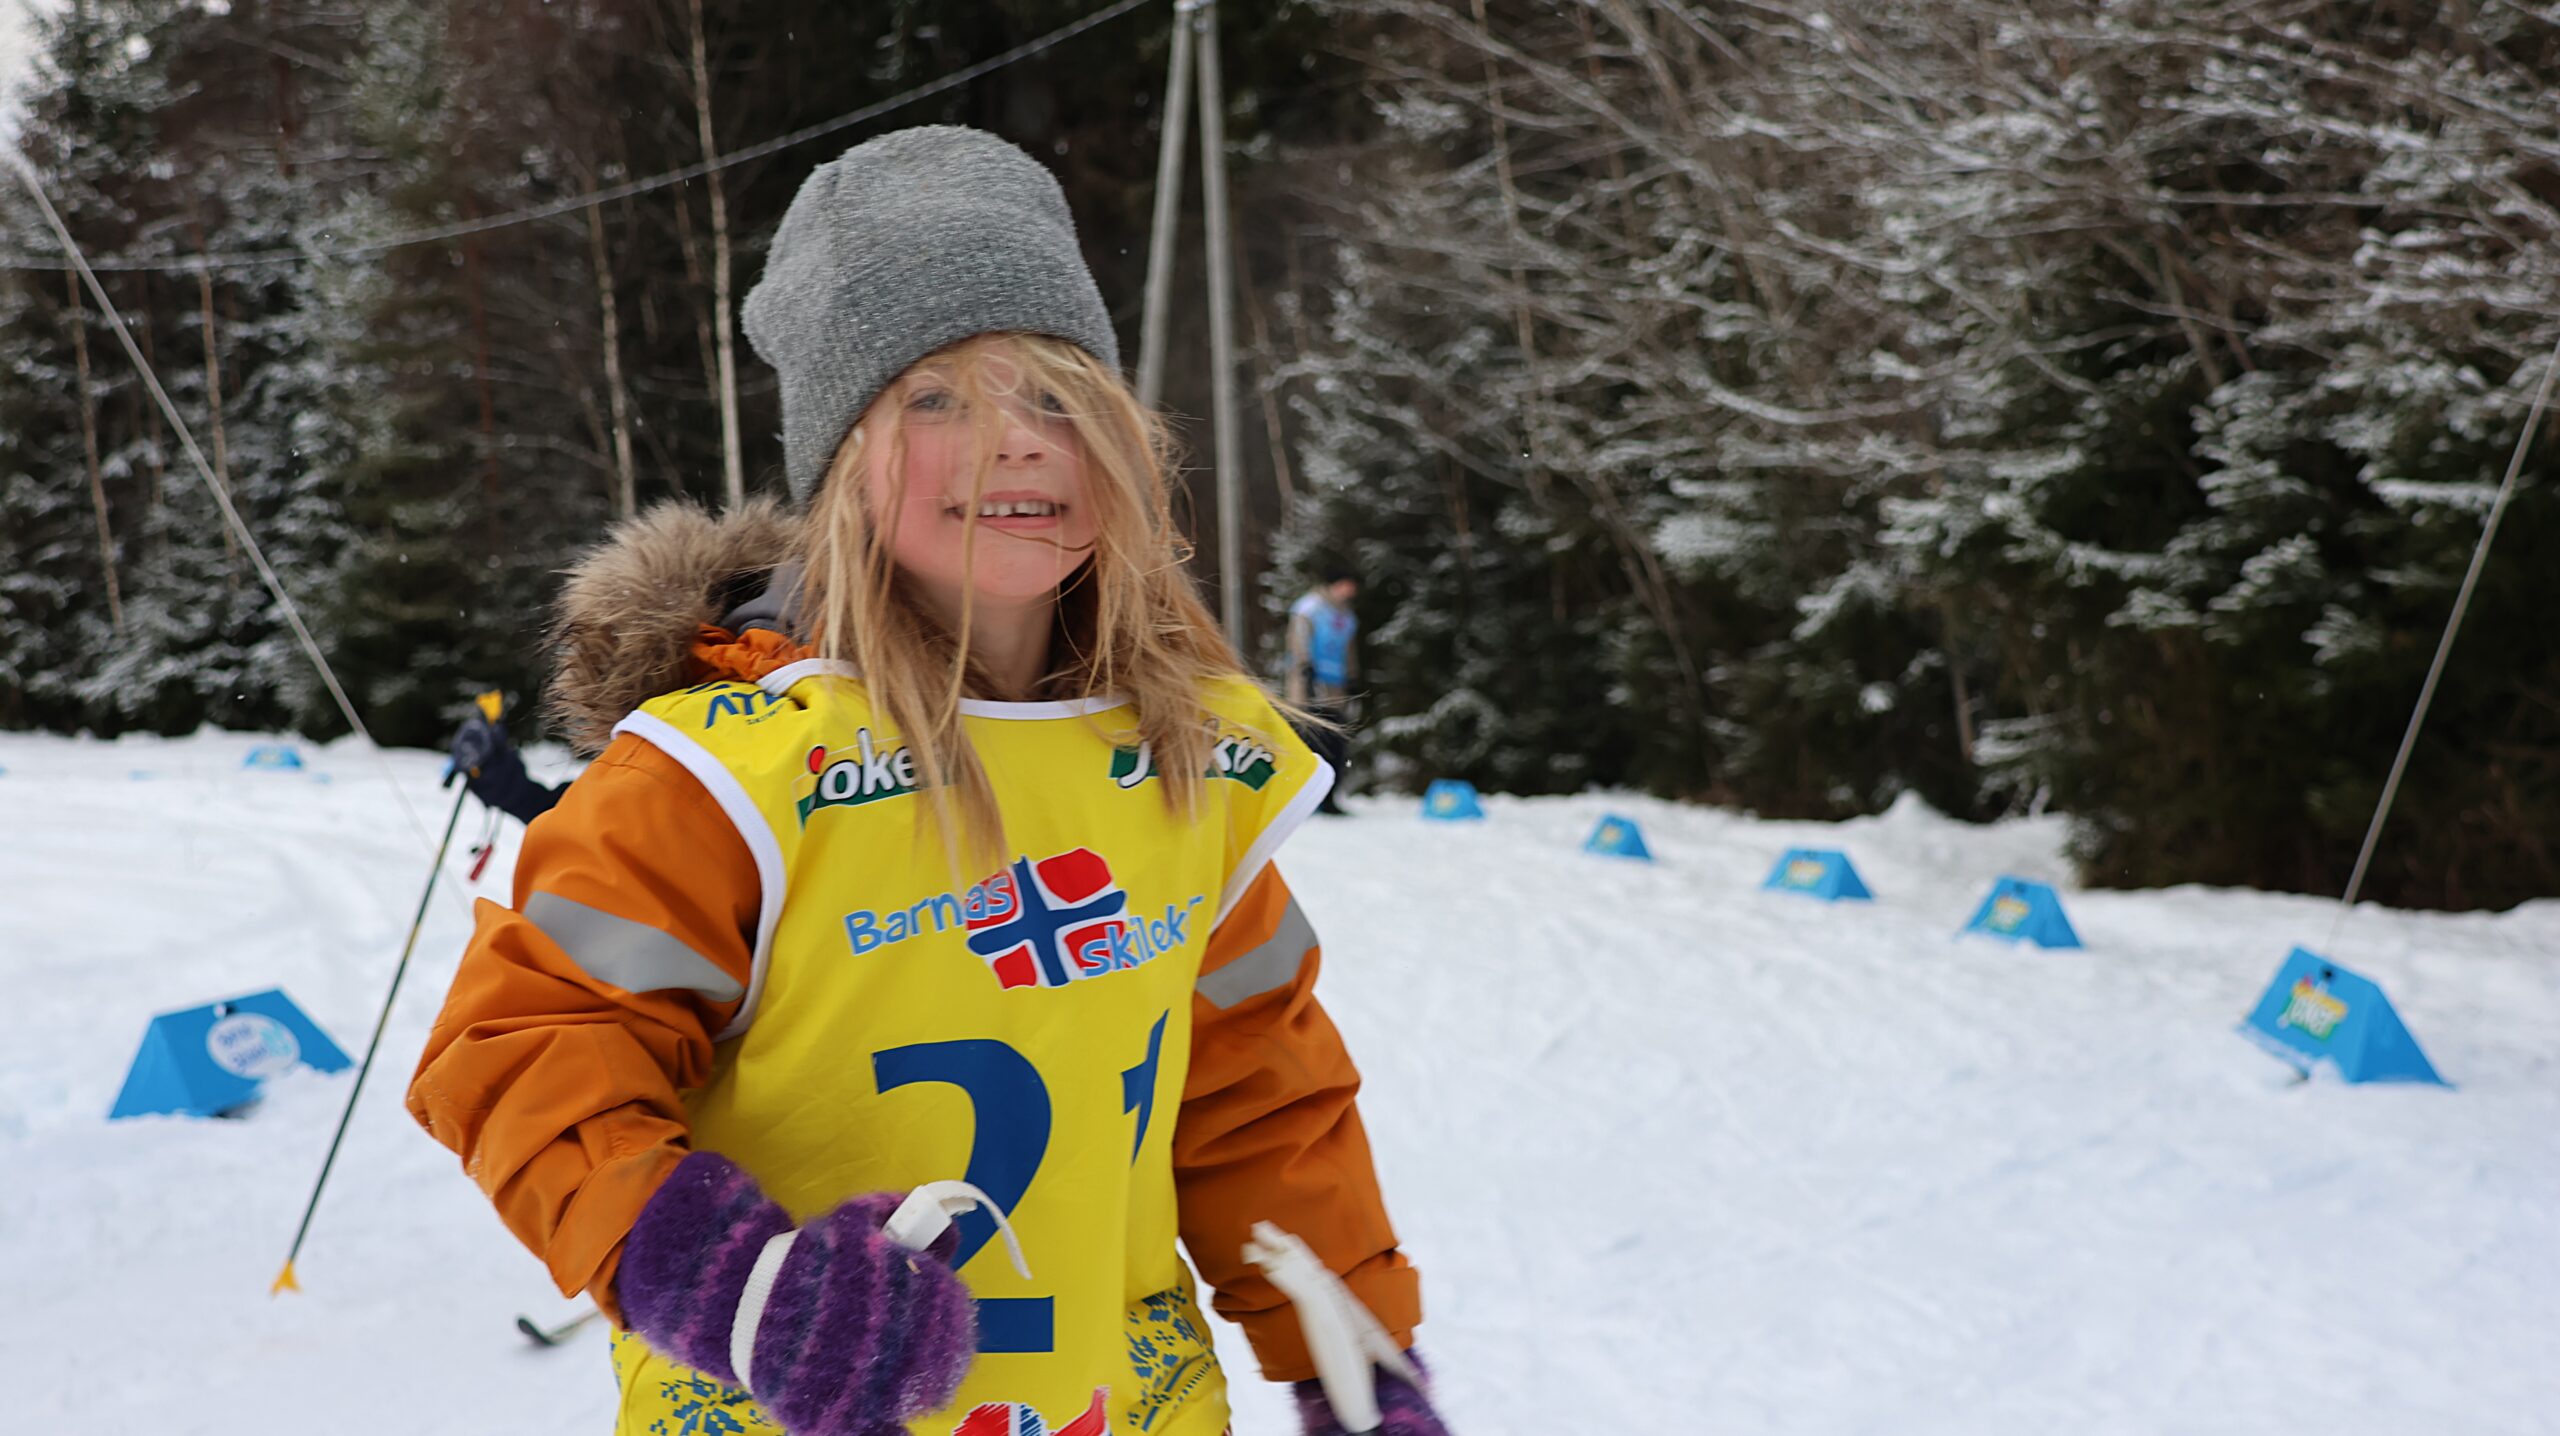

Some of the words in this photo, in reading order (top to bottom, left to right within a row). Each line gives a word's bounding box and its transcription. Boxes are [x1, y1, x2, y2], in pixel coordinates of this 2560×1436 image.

[805, 726, 918, 816] joke
[1117, 717, 1275, 789] jker
[843, 874, 1016, 956] Barnas
[1079, 894, 1205, 977] skilek
